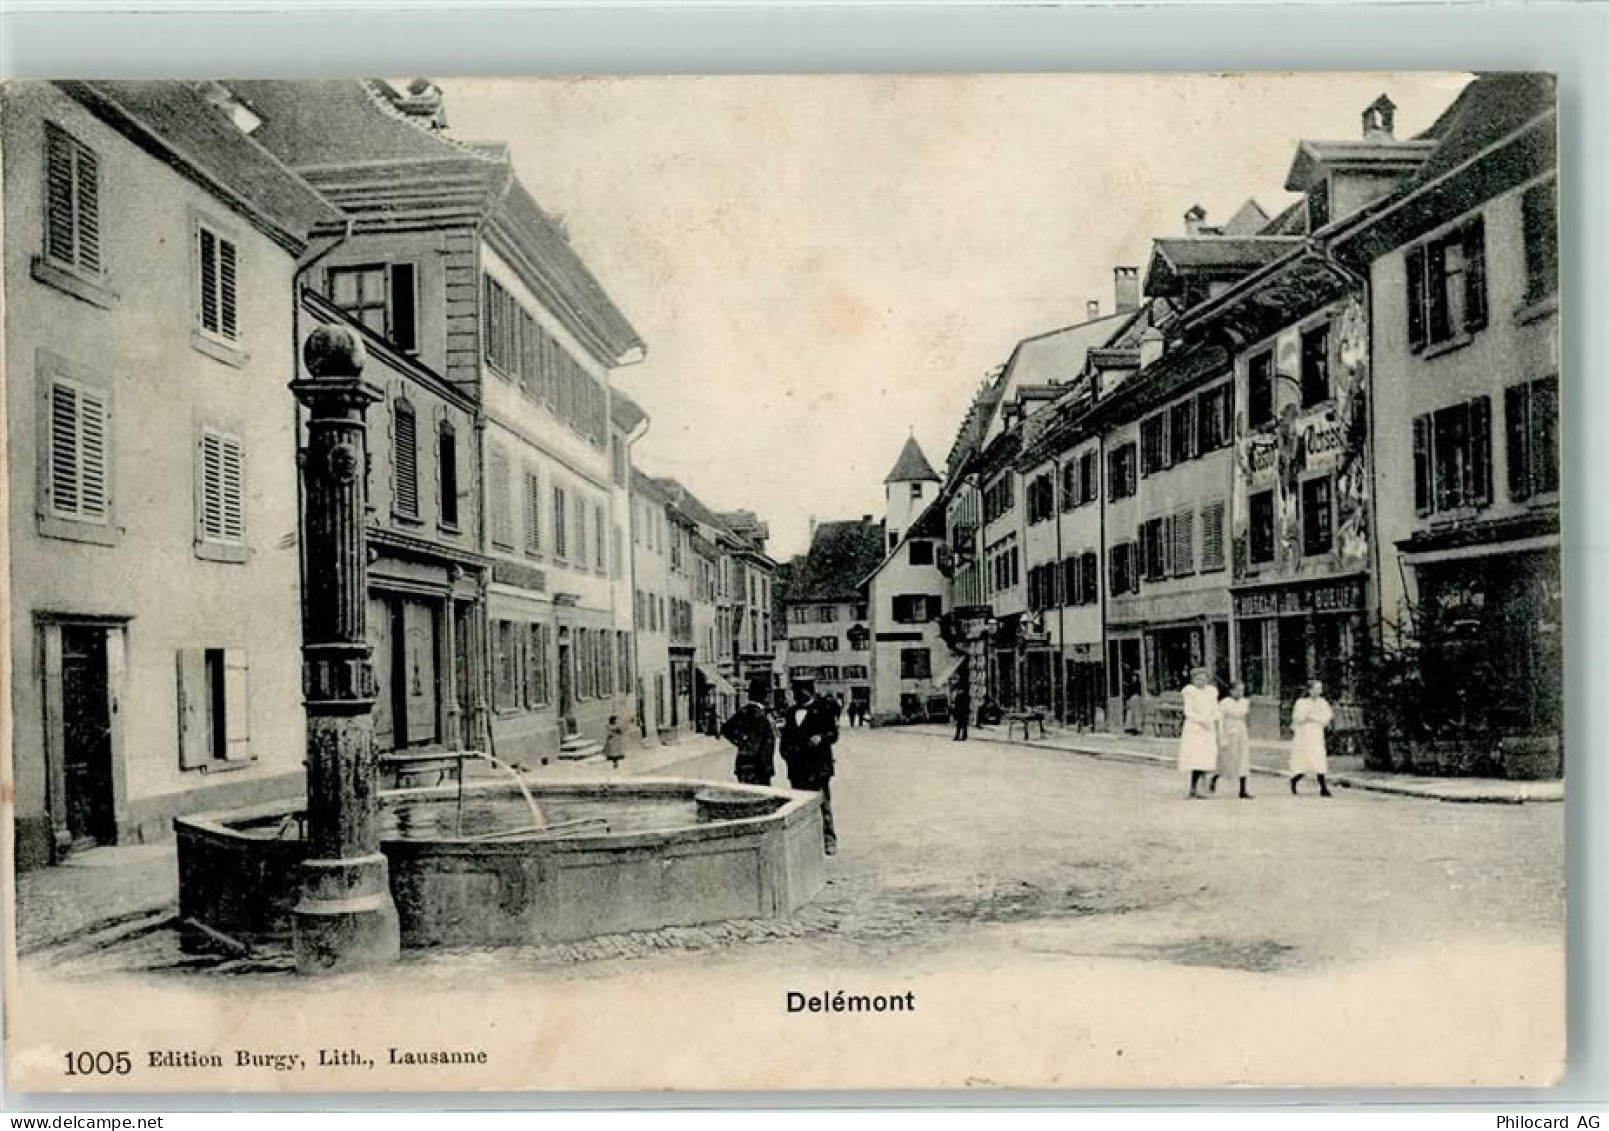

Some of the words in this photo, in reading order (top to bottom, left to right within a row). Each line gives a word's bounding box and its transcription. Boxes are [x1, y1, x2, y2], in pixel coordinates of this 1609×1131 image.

[786, 989, 915, 1013] Delémont
[64, 1051, 132, 1076] 1005
[148, 1049, 222, 1068] Edition
[236, 1049, 305, 1072] Burgy,
[318, 1048, 375, 1069] Lith.,
[388, 1047, 488, 1066] Lausanne
